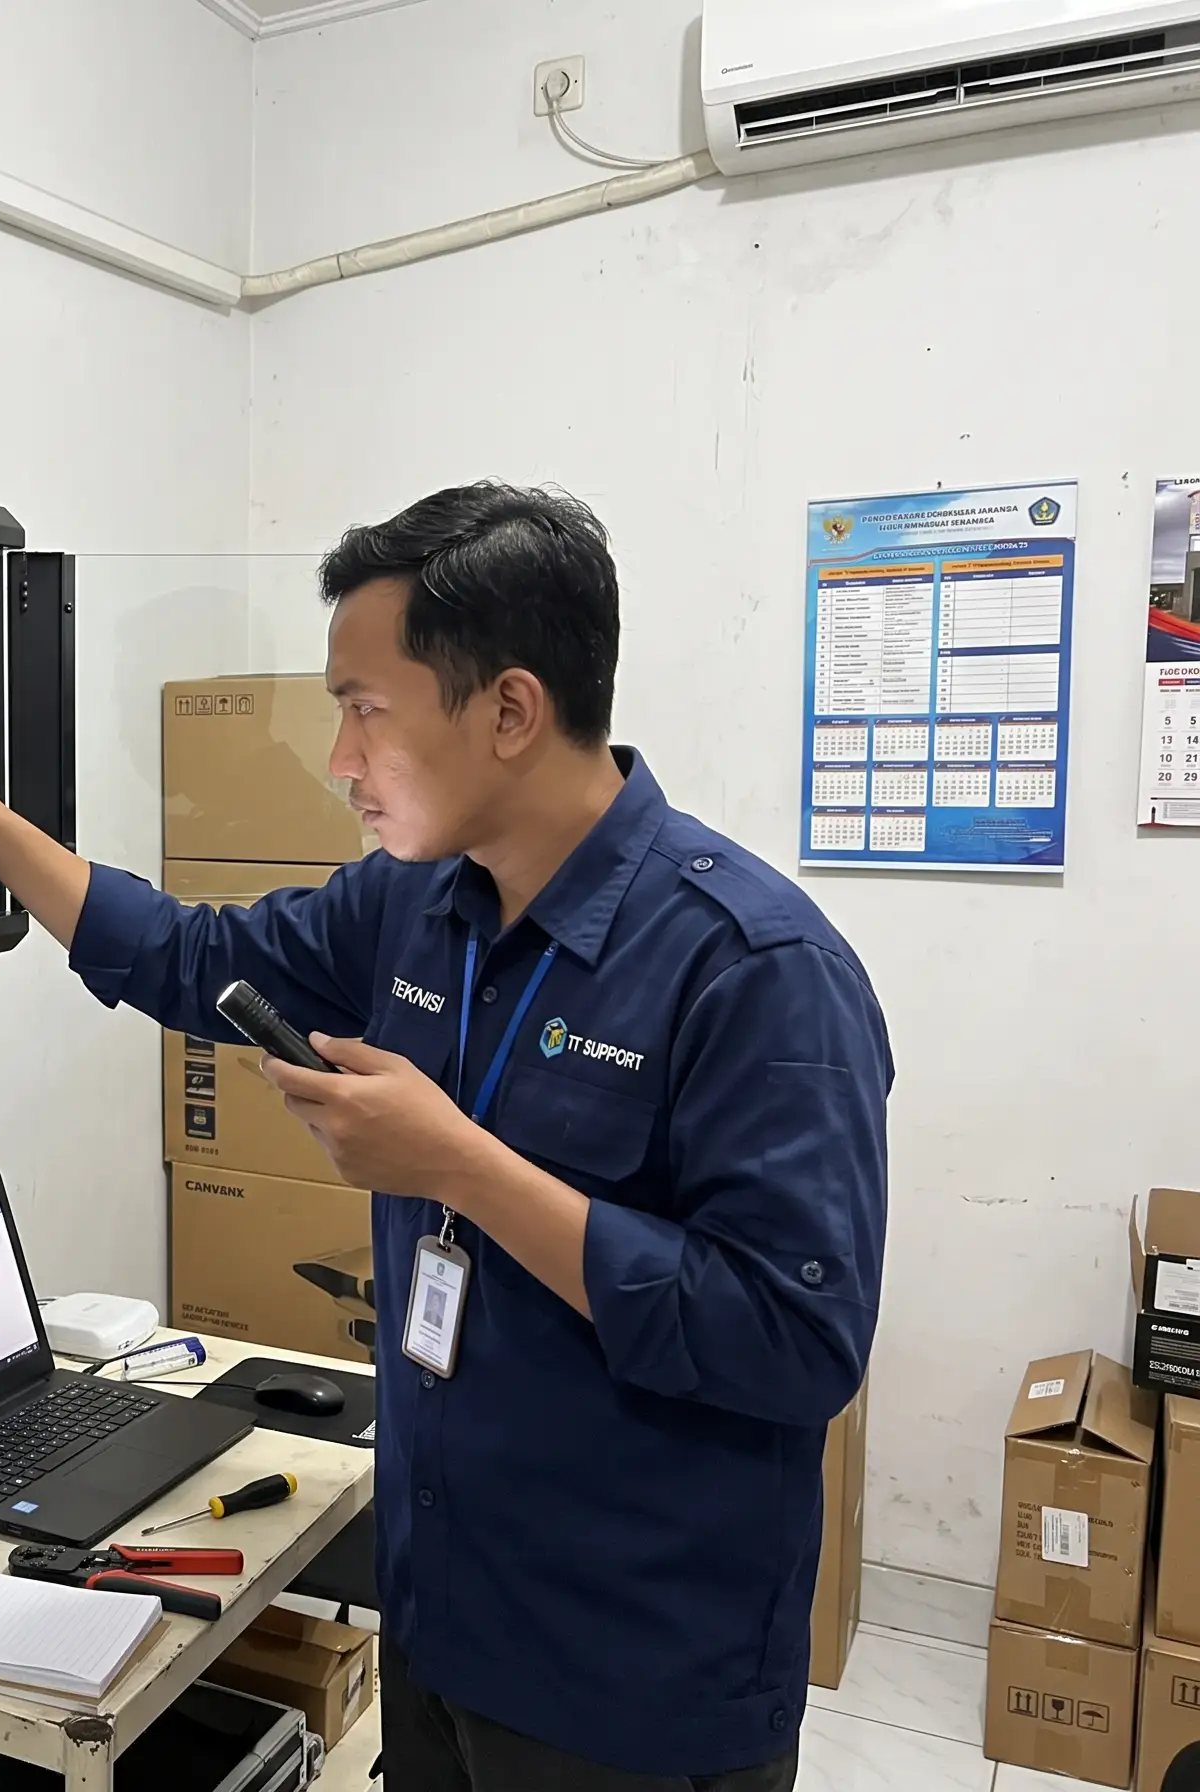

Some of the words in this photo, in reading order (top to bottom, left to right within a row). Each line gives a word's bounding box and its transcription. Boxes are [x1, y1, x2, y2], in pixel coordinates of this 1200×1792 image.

[1164, 716, 1171, 725] 5
[1190, 716, 1197, 725] 5
[1161, 735, 1173, 744] 13
[1186, 735, 1199, 744] 14
[1159, 753, 1173, 762] 10
[1185, 753, 1198, 762] 21
[1158, 772, 1172, 781] 20
[1184, 772, 1198, 781] 29
[391, 976, 446, 1014] TEKNISI
[582, 1039, 645, 1071] SUPPORT
